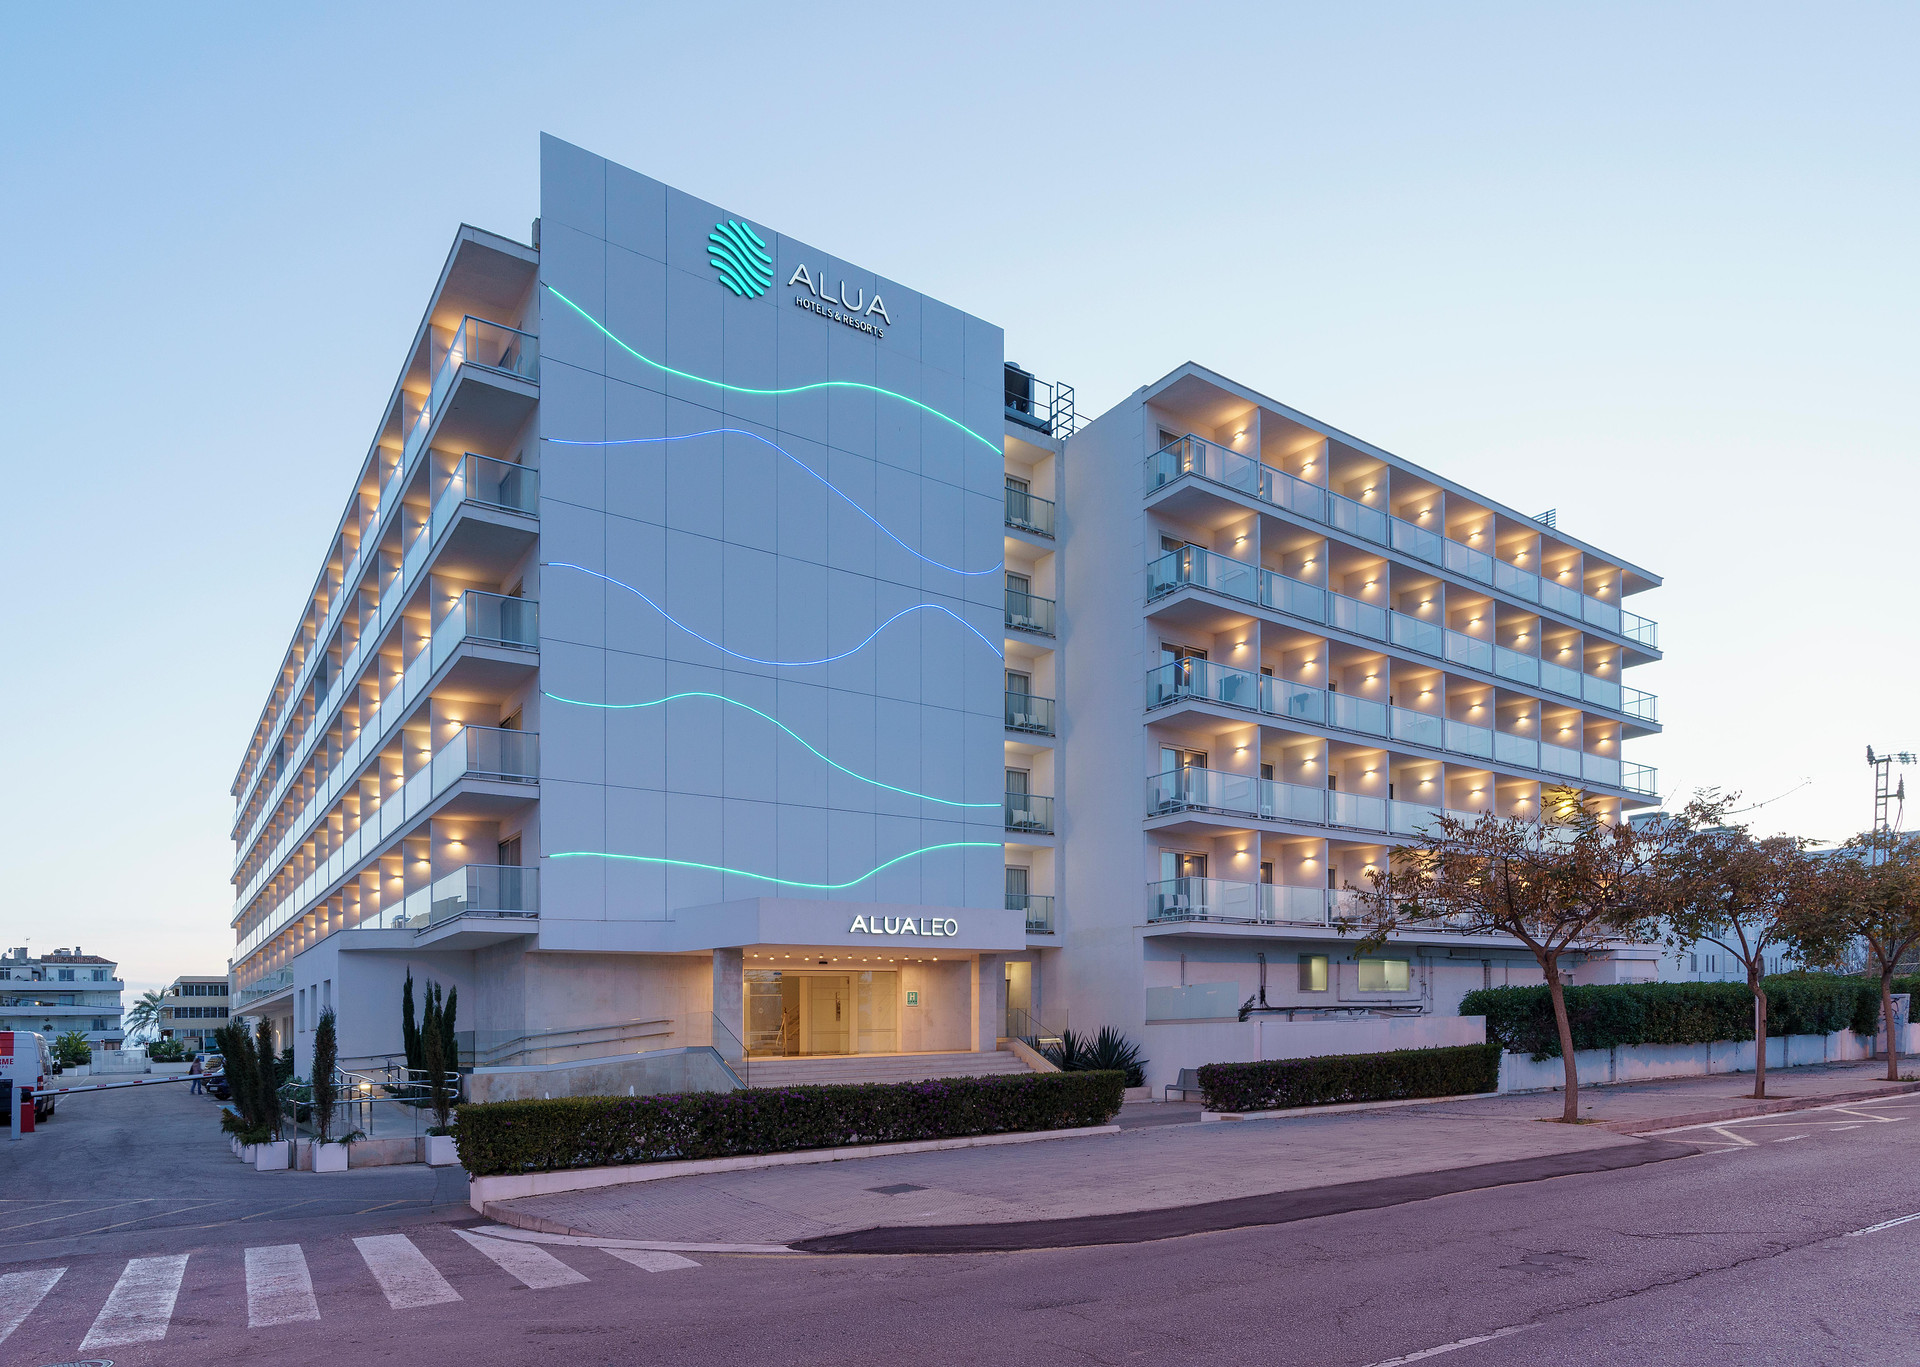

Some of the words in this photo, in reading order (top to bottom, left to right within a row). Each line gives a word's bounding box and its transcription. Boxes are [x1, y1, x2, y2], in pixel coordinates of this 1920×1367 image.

[788, 264, 890, 324] ALUA
[795, 296, 832, 318] HOTELS
[834, 311, 842, 321] &
[843, 314, 884, 338] RESORTS
